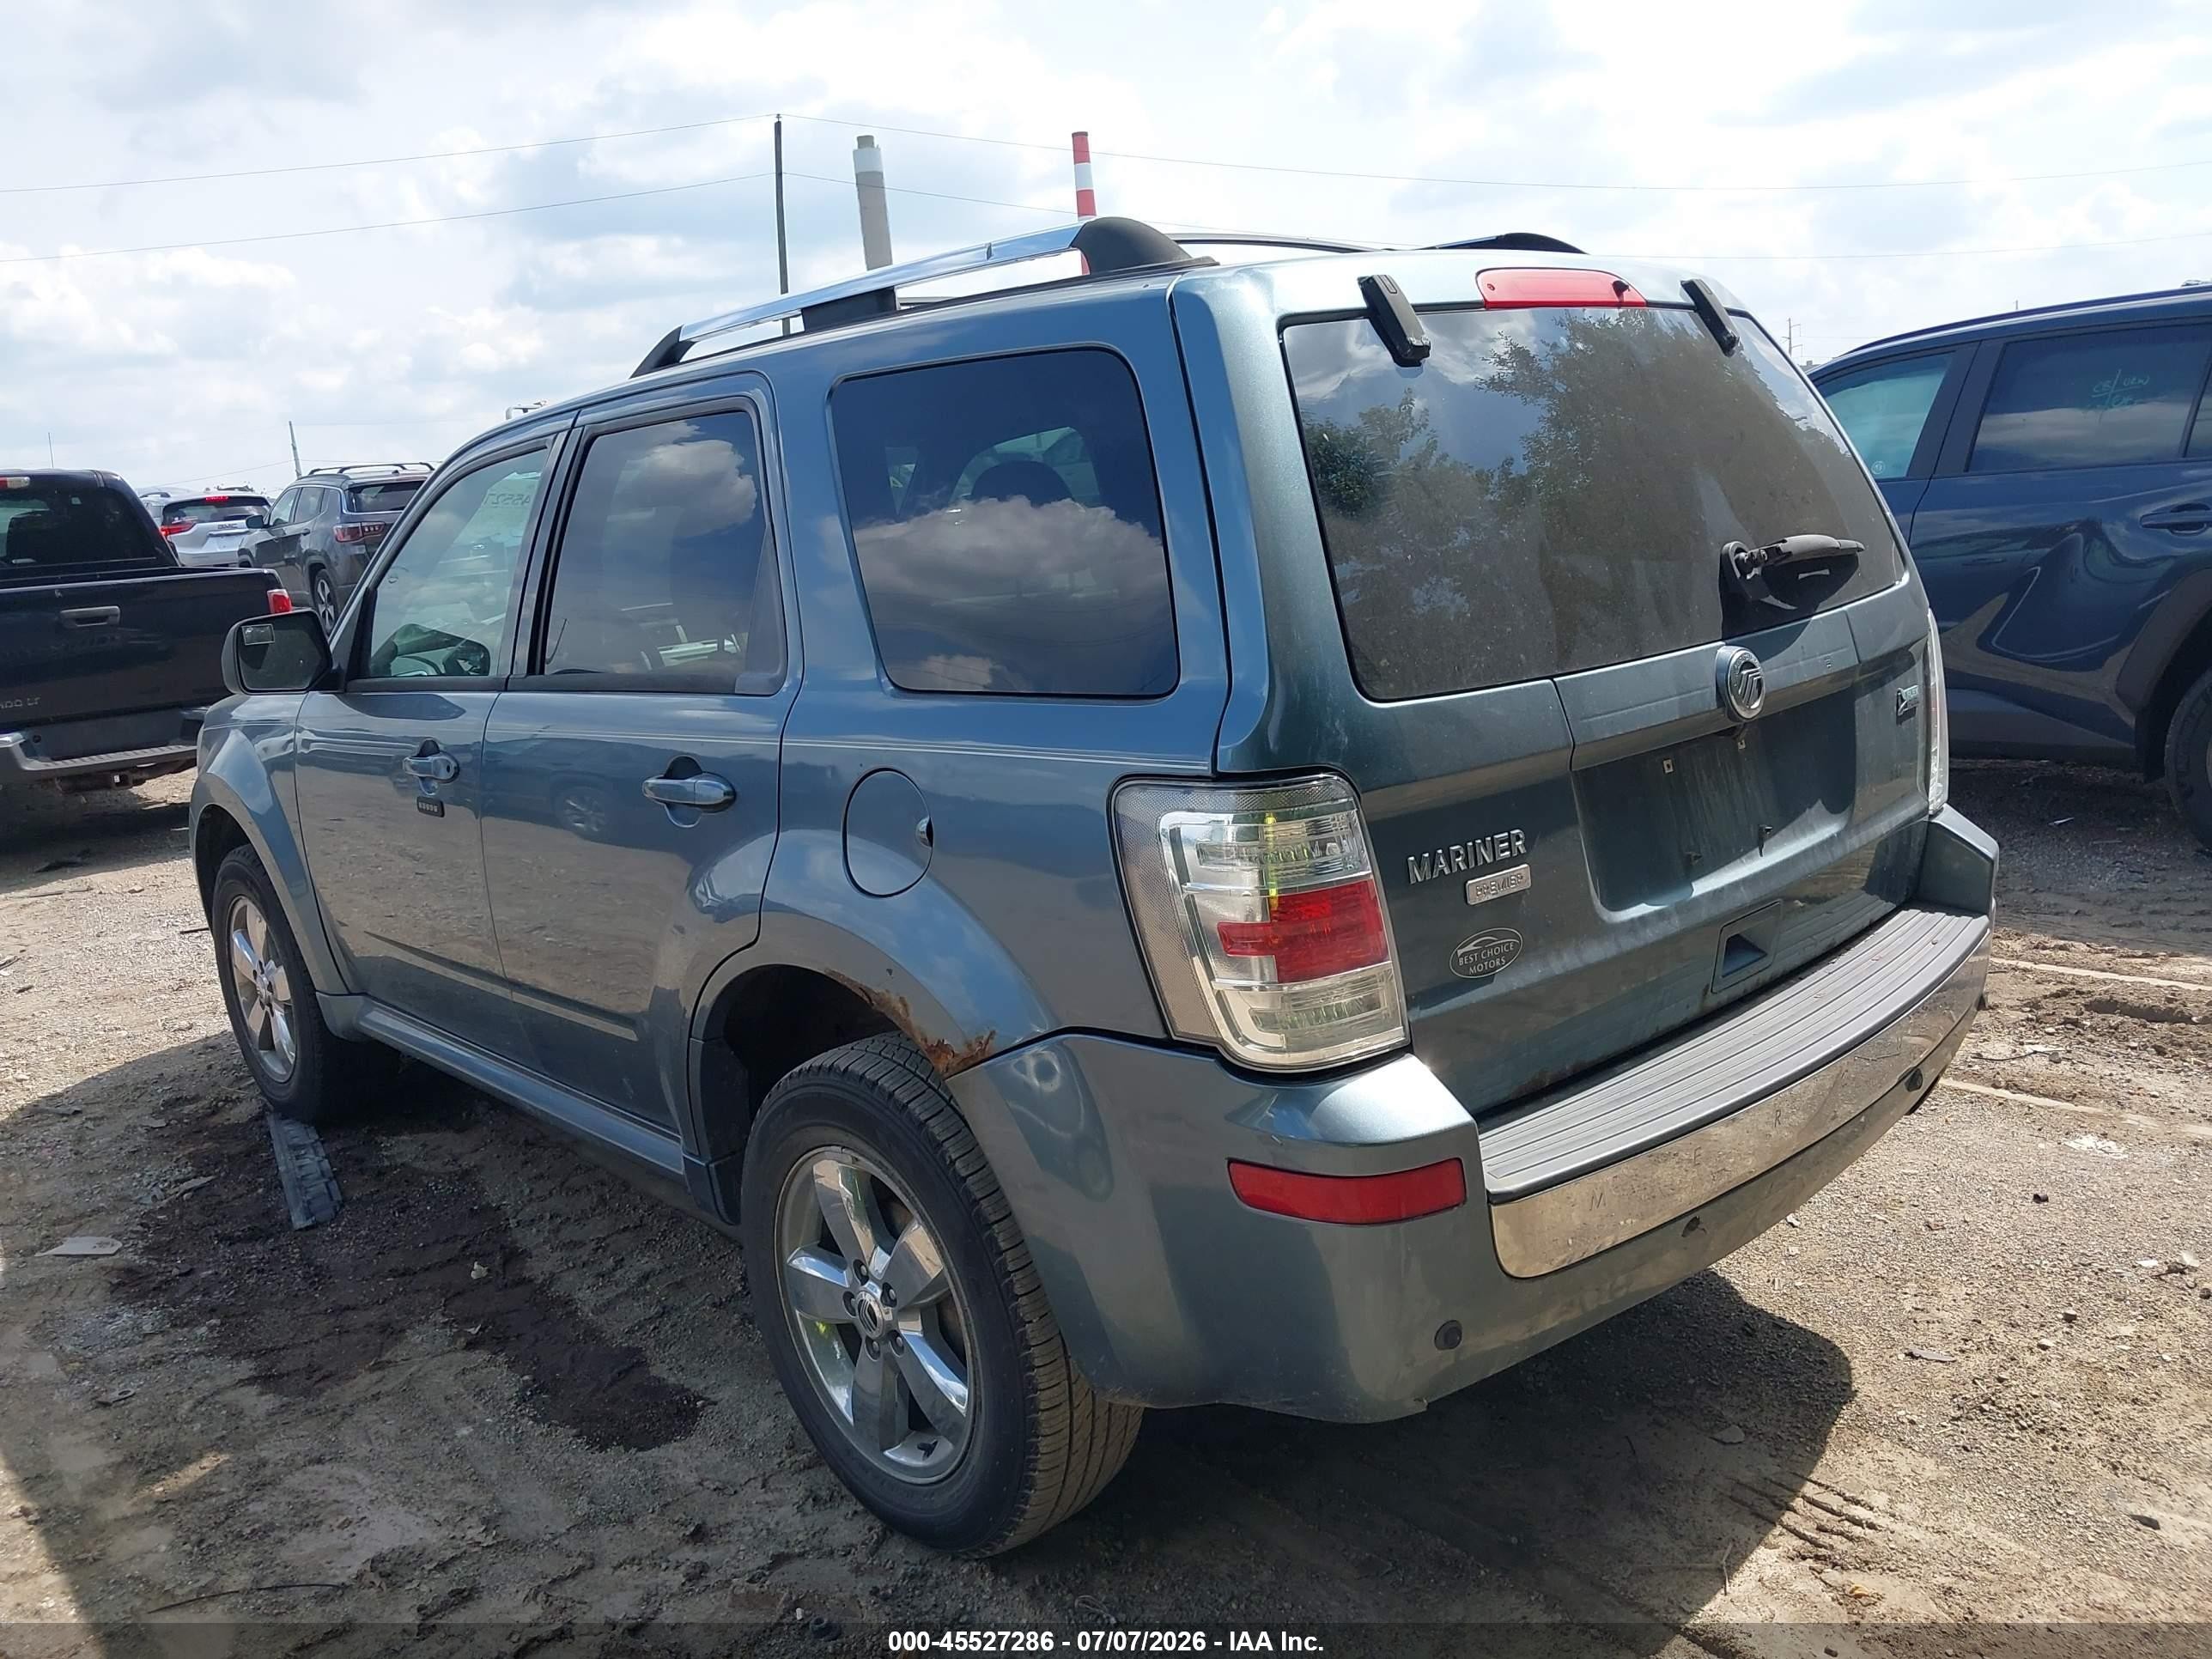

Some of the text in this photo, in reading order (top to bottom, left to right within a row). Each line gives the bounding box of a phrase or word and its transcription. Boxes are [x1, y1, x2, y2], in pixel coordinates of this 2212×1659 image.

[1407, 829, 1527, 884] MARINER
[1475, 872, 1524, 898] PREMIER
[1459, 942, 1514, 966] BEST CHOICE
[1469, 956, 1505, 975] MOTORS
